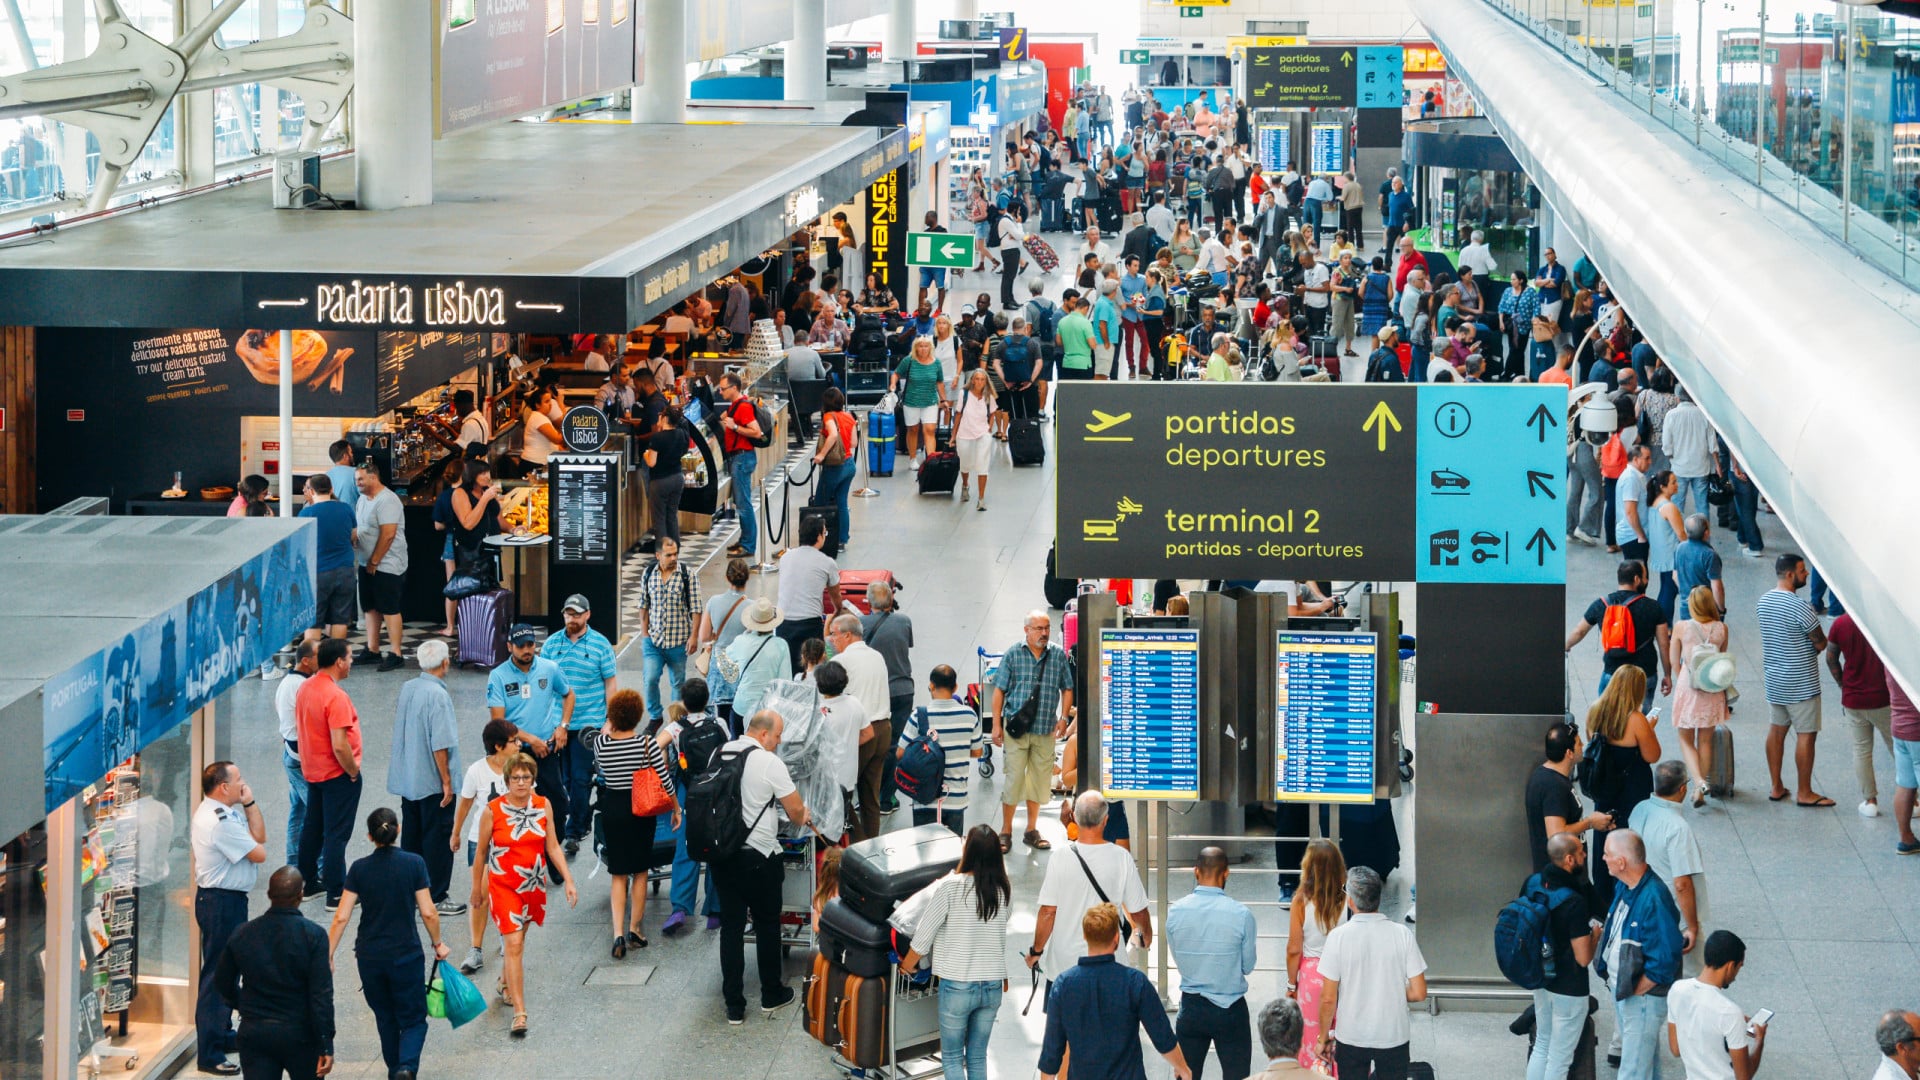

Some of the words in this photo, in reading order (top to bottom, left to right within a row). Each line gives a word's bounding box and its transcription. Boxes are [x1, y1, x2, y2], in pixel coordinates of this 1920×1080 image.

[1279, 54, 1321, 65] partidas
[1279, 64, 1330, 74] departures
[1279, 84, 1320, 94] terminal
[1322, 84, 1329, 94] 2
[183, 333, 192, 342] os
[193, 328, 220, 340] nossos
[131, 348, 169, 362] deliciosos
[198, 340, 208, 351] de
[165, 357, 198, 371] delicious
[199, 351, 226, 365] custard
[162, 370, 185, 381] cream
[1166, 410, 1296, 440] partidas
[1166, 442, 1326, 471] departures
[1165, 508, 1294, 533] terminal
[1304, 509, 1320, 533] 2
[1166, 541, 1241, 559] partidas
[1257, 541, 1364, 560] departures
[1432, 537, 1457, 545] metro
[50, 669, 98, 711] PORTUGAL
